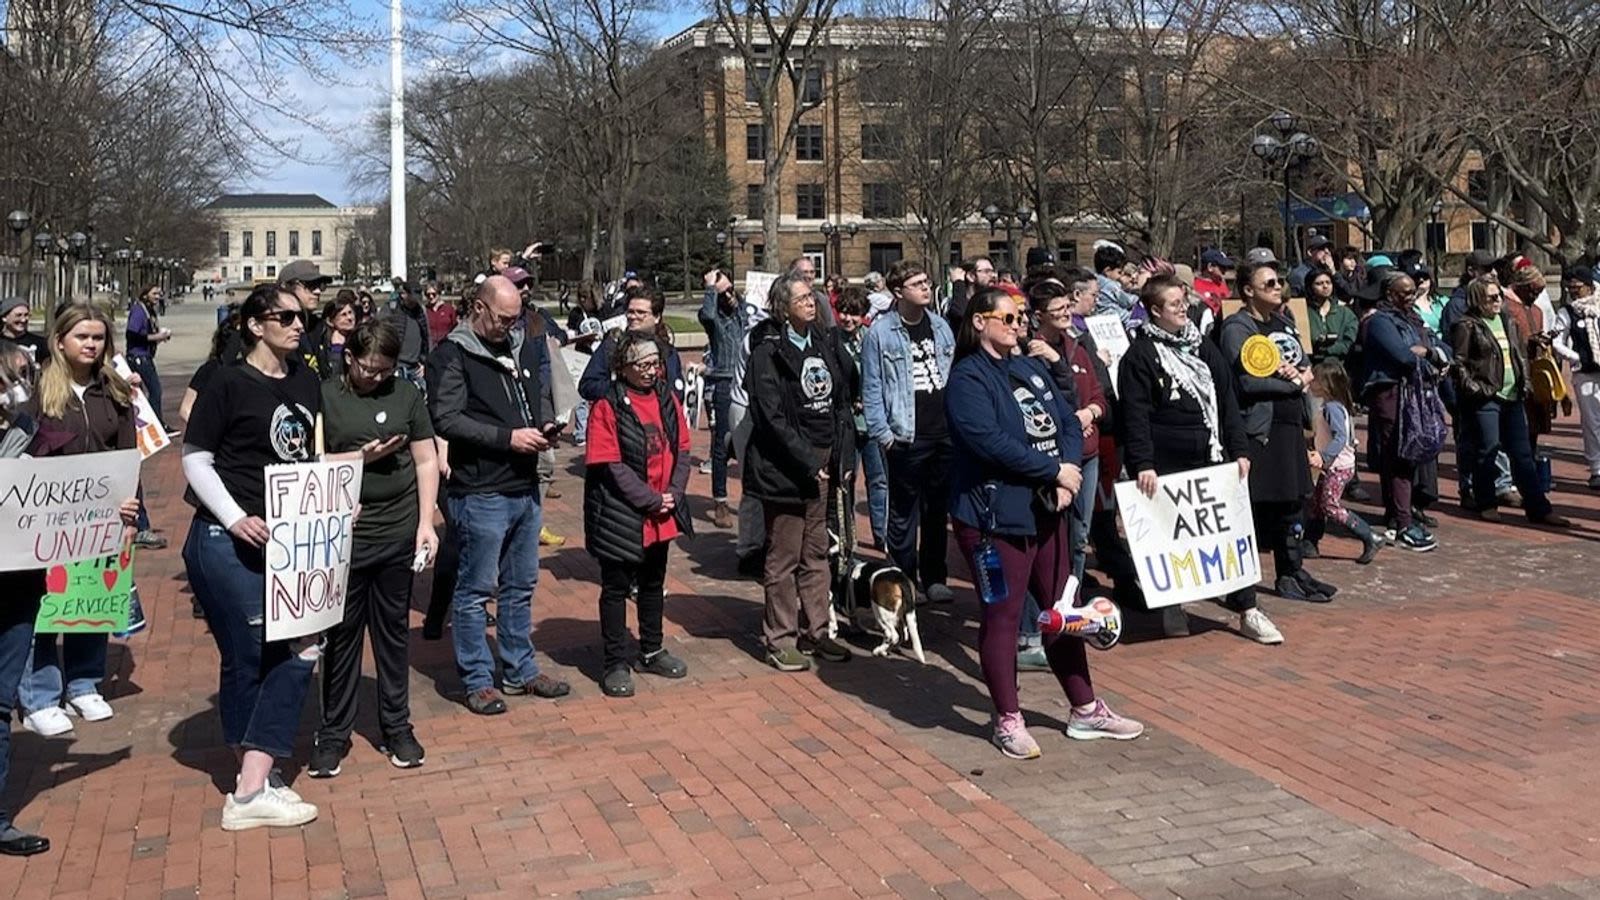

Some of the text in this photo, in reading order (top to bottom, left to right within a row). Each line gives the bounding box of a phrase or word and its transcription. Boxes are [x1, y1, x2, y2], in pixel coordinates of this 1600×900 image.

[0, 473, 110, 509] WORKERS
[270, 465, 354, 519] FAIR
[1163, 477, 1216, 507] WE
[17, 508, 114, 530] OF THE WORLD
[1173, 502, 1231, 541] ARE
[270, 513, 352, 572] SHARE
[1145, 534, 1258, 592] UMMAP!
[42, 593, 130, 619] SERVICE?
